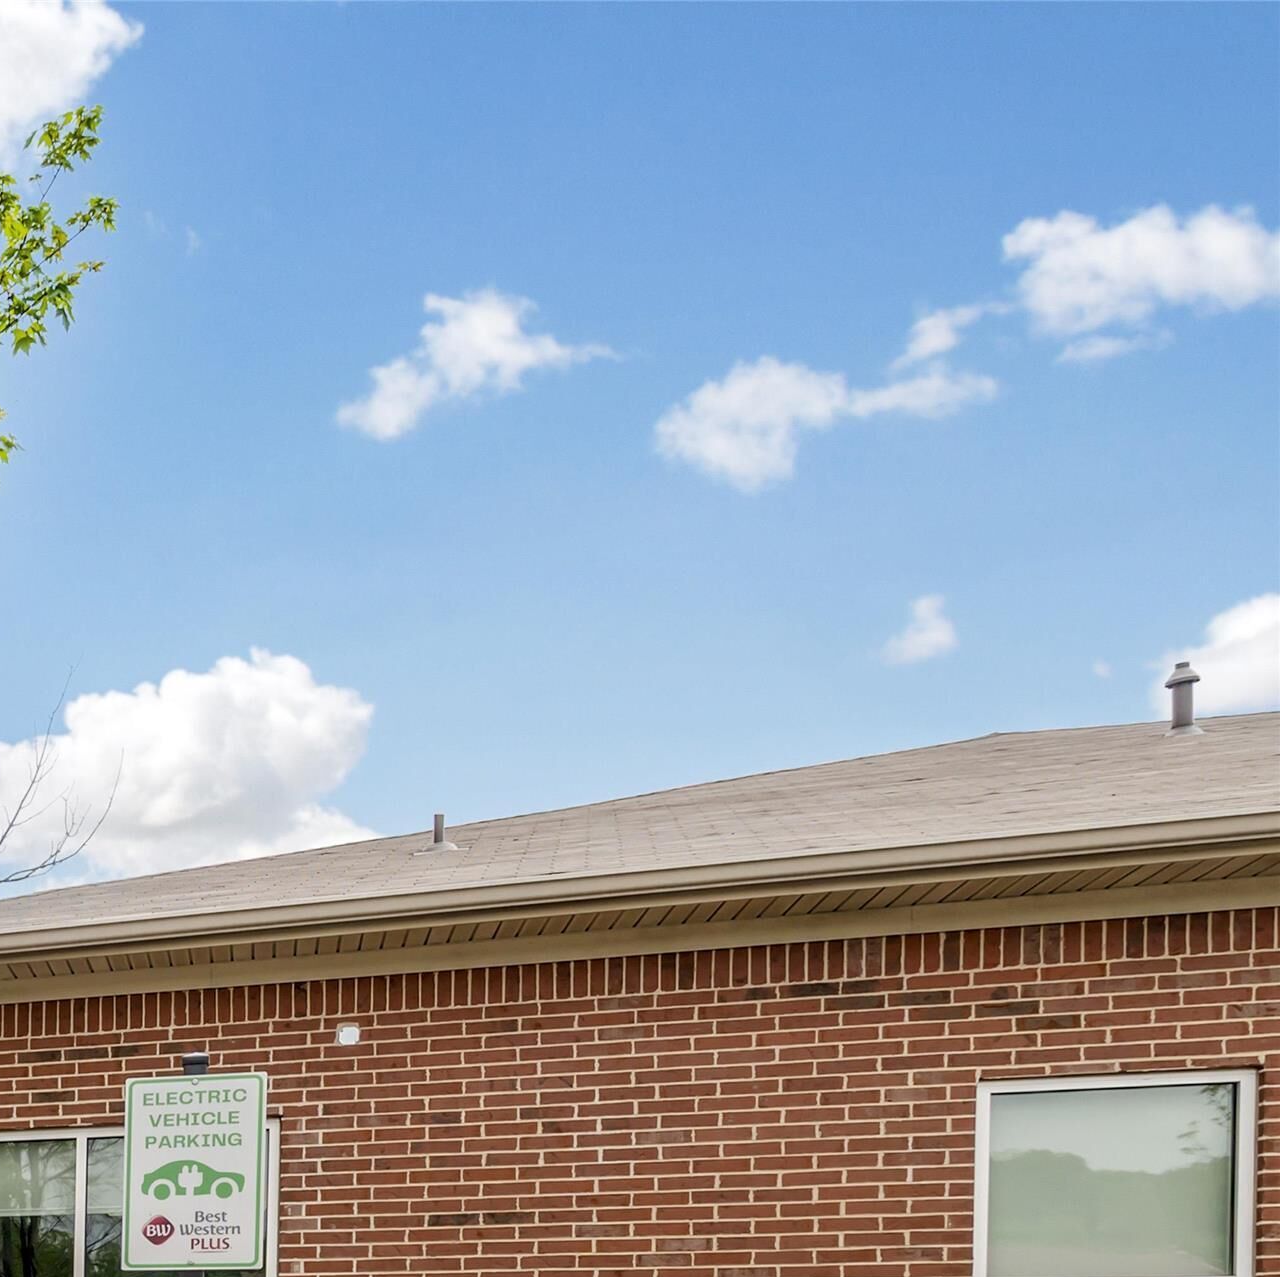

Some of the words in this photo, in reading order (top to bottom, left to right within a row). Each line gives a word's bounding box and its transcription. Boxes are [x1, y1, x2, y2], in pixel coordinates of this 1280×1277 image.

[142, 1088, 248, 1107] ELECTRIC
[149, 1110, 241, 1128] VEHICLE
[145, 1132, 243, 1149] PARKING
[194, 1210, 228, 1223] Best
[146, 1224, 171, 1237] BW
[179, 1223, 241, 1236] Western
[190, 1237, 230, 1250] PLUS
